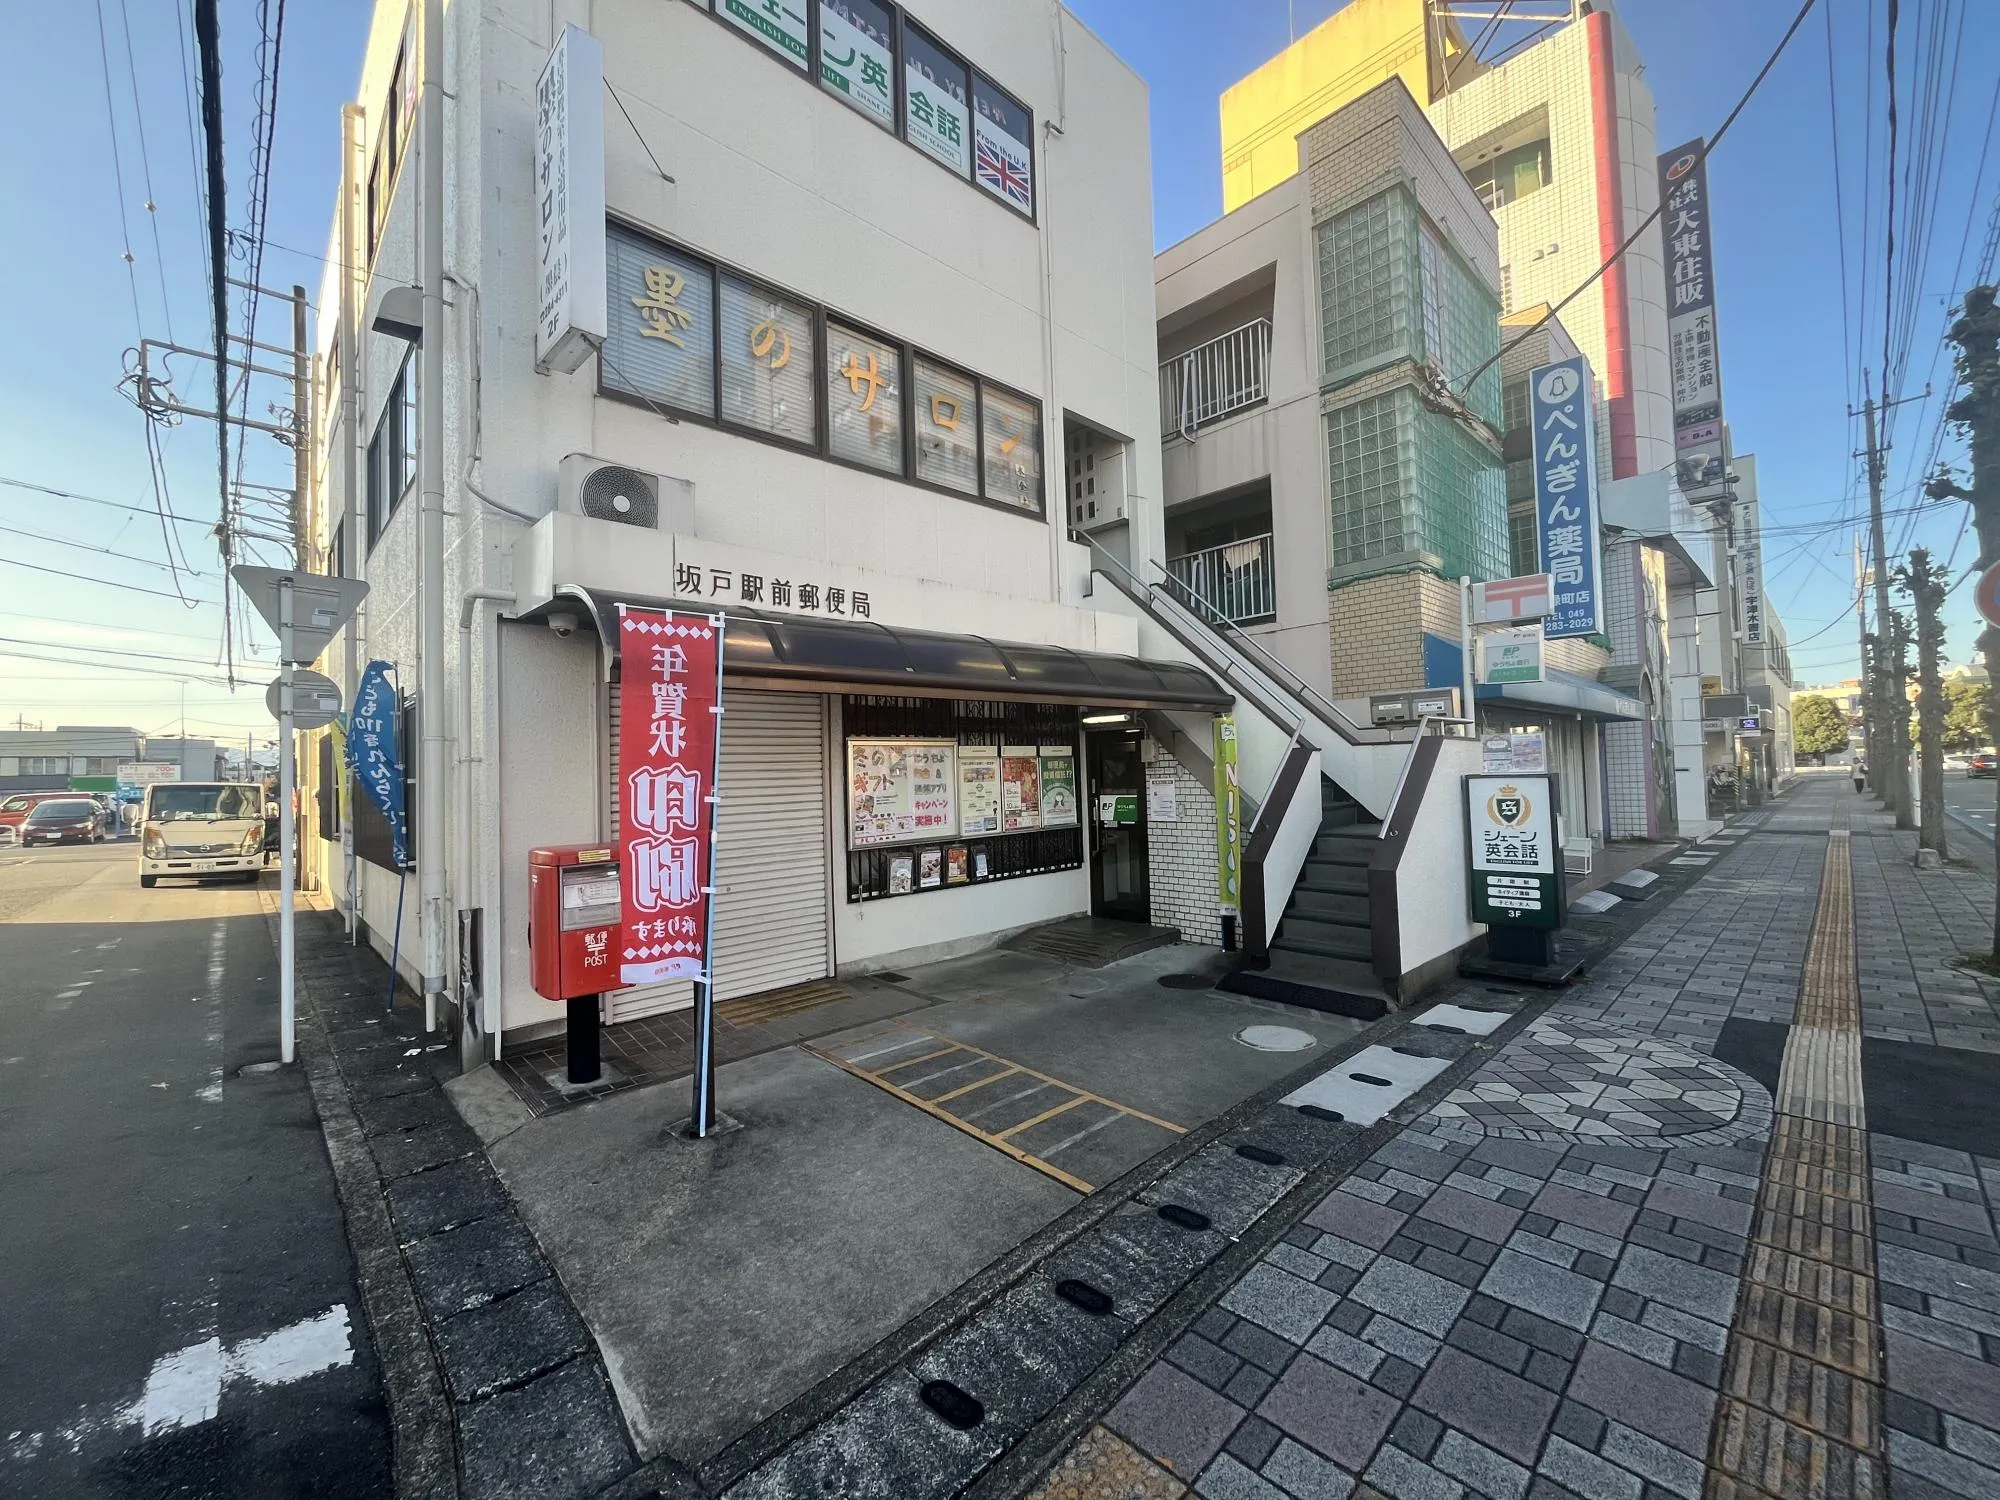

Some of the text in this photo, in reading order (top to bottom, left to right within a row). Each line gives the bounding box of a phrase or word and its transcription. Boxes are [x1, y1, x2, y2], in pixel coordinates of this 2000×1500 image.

[732, 1, 781, 41] ENGLISH
[785, 37, 808, 59] FOR
[976, 129, 998, 151] From
[999, 145, 1013, 160] the
[538, 65, 556, 266] 墨のサロン
[1669, 209, 1705, 309] 大東住販
[546, 311, 560, 340] 2F
[1695, 314, 1713, 388] 不動産全般
[1543, 404, 1584, 587] ぺんぎん薬局
[676, 562, 870, 618] 坂戸駅前郵便局
[1545, 617, 1594, 632] 283-2029
[1568, 608, 1585, 619] 049
[853, 771, 894, 793] ギフト
[914, 797, 949, 811] キャンペーン
[1484, 830, 1537, 843] シェーン
[1485, 843, 1539, 860] 英会話
[1508, 910, 1522, 918] 3F
[584, 931, 608, 945] 郵便
[584, 954, 609, 968] POST
